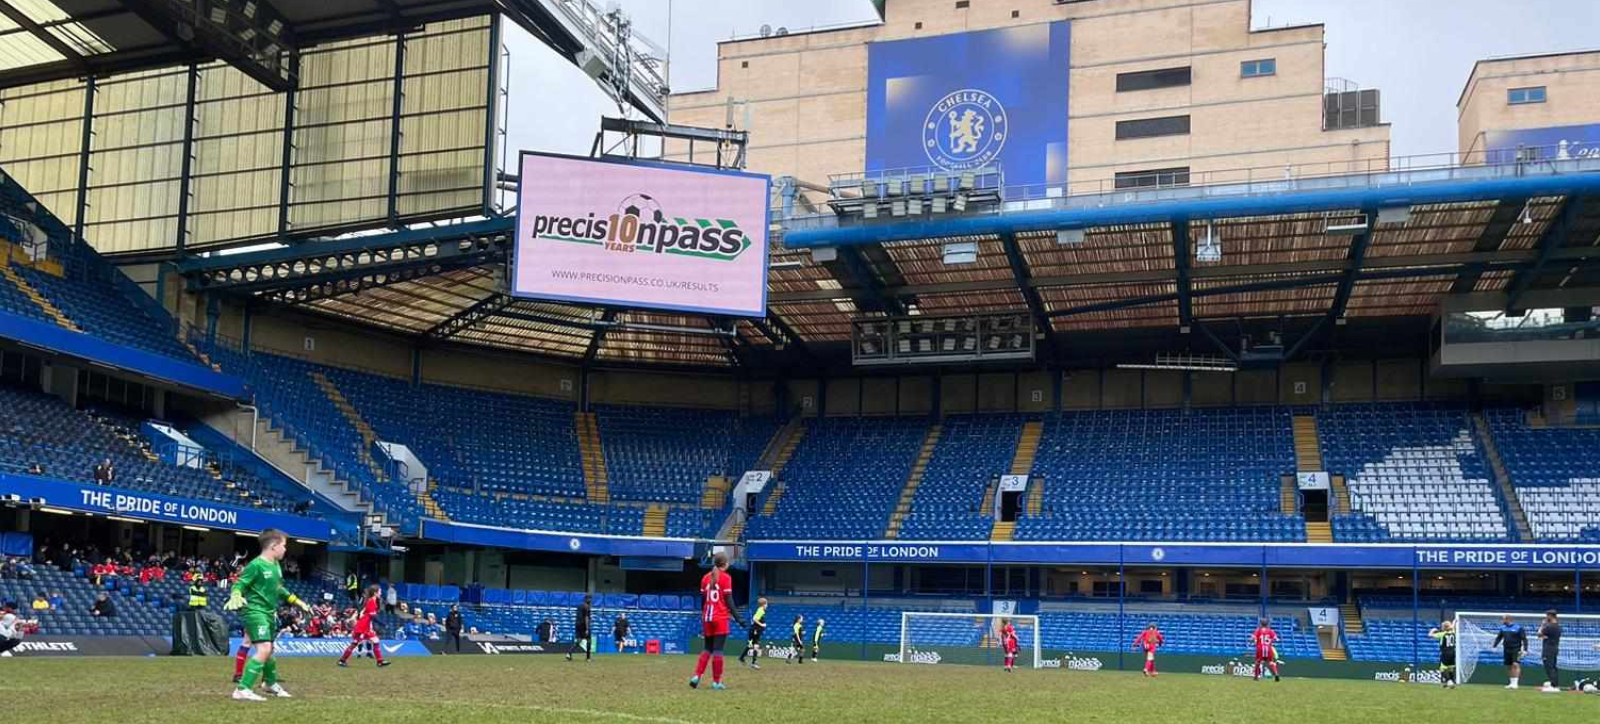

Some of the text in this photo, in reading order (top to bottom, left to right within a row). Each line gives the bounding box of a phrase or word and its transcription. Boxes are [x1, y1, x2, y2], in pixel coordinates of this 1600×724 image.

[938, 92, 992, 112] CHELSEA
[604, 241, 635, 253] YEARS
[551, 269, 719, 292] WWW.PRECISIONPASS.CO.UK/RESULTS
[756, 472, 763, 482] 2
[1012, 476, 1019, 486] 3
[81, 490, 237, 524] THE PRIDE OF LONDON
[796, 546, 820, 557] THE
[824, 546, 862, 557] PRIDE
[882, 546, 938, 558] LONDON
[1416, 550, 1600, 564] THE PRIDE OF LONDO
[1002, 601, 1010, 611] 3
[1319, 608, 1327, 617] 4
[1445, 633, 1455, 647] 10
